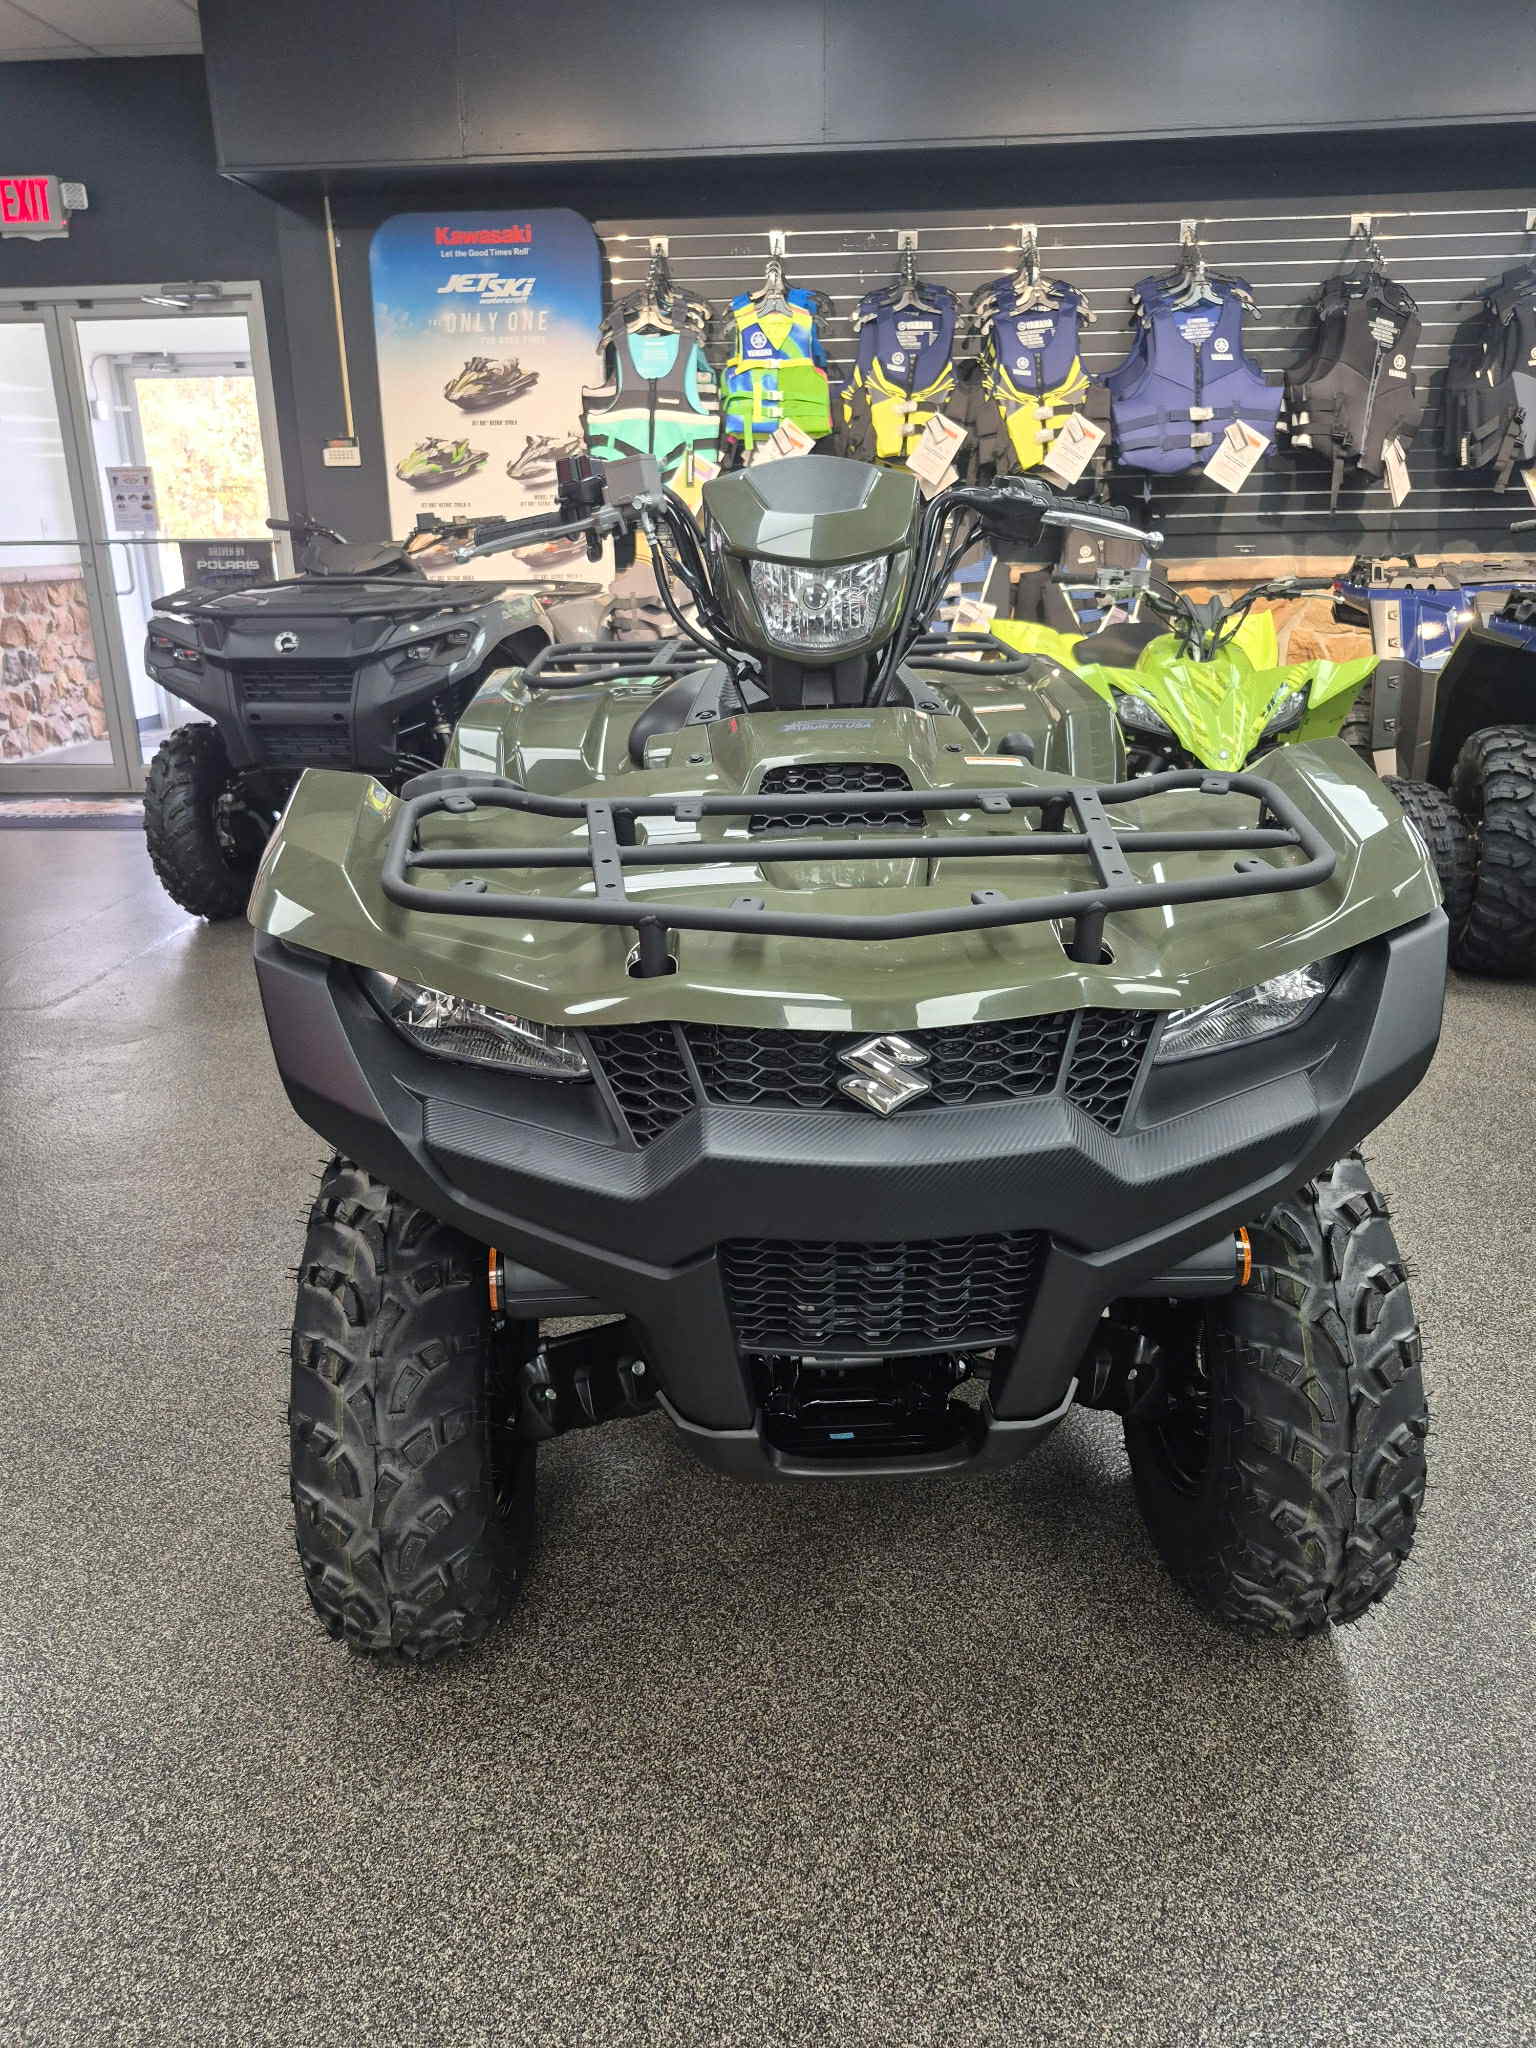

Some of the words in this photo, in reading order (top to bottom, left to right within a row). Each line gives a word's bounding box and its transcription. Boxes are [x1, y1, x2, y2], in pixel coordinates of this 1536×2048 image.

[0, 177, 50, 224] EXIT
[435, 224, 533, 246] Kawasaki
[440, 250, 453, 258] Let
[455, 249, 467, 258] the
[468, 248, 489, 257] Good
[489, 248, 512, 256] Times
[513, 247, 529, 256] Roll
[447, 312, 498, 334] ONLY
[508, 310, 549, 332] ONE
[196, 560, 260, 570] POLARIS
